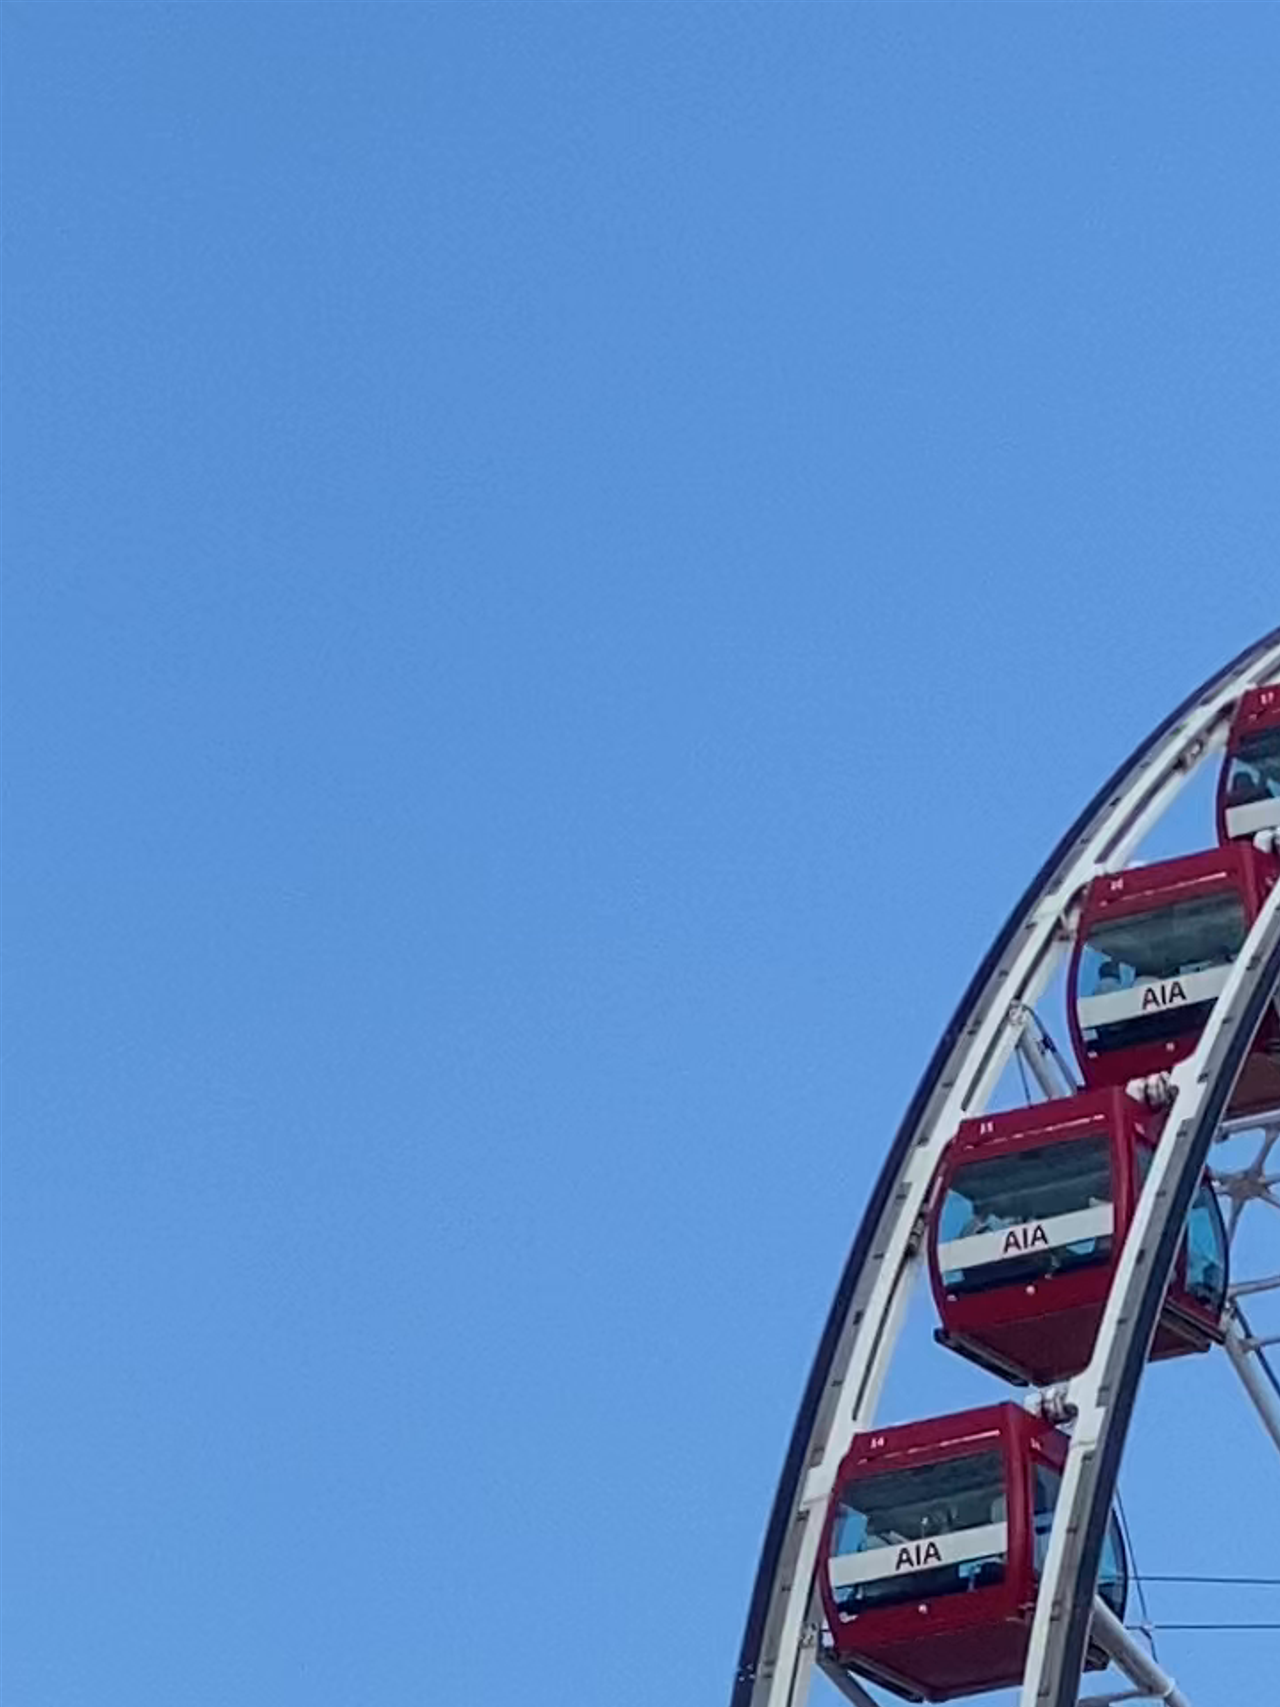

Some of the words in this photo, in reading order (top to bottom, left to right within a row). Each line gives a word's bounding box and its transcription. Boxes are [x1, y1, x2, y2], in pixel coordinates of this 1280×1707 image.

[1141, 982, 1188, 1011] AIA
[1002, 1224, 1049, 1252] AIA
[895, 1541, 942, 1571] AIA
